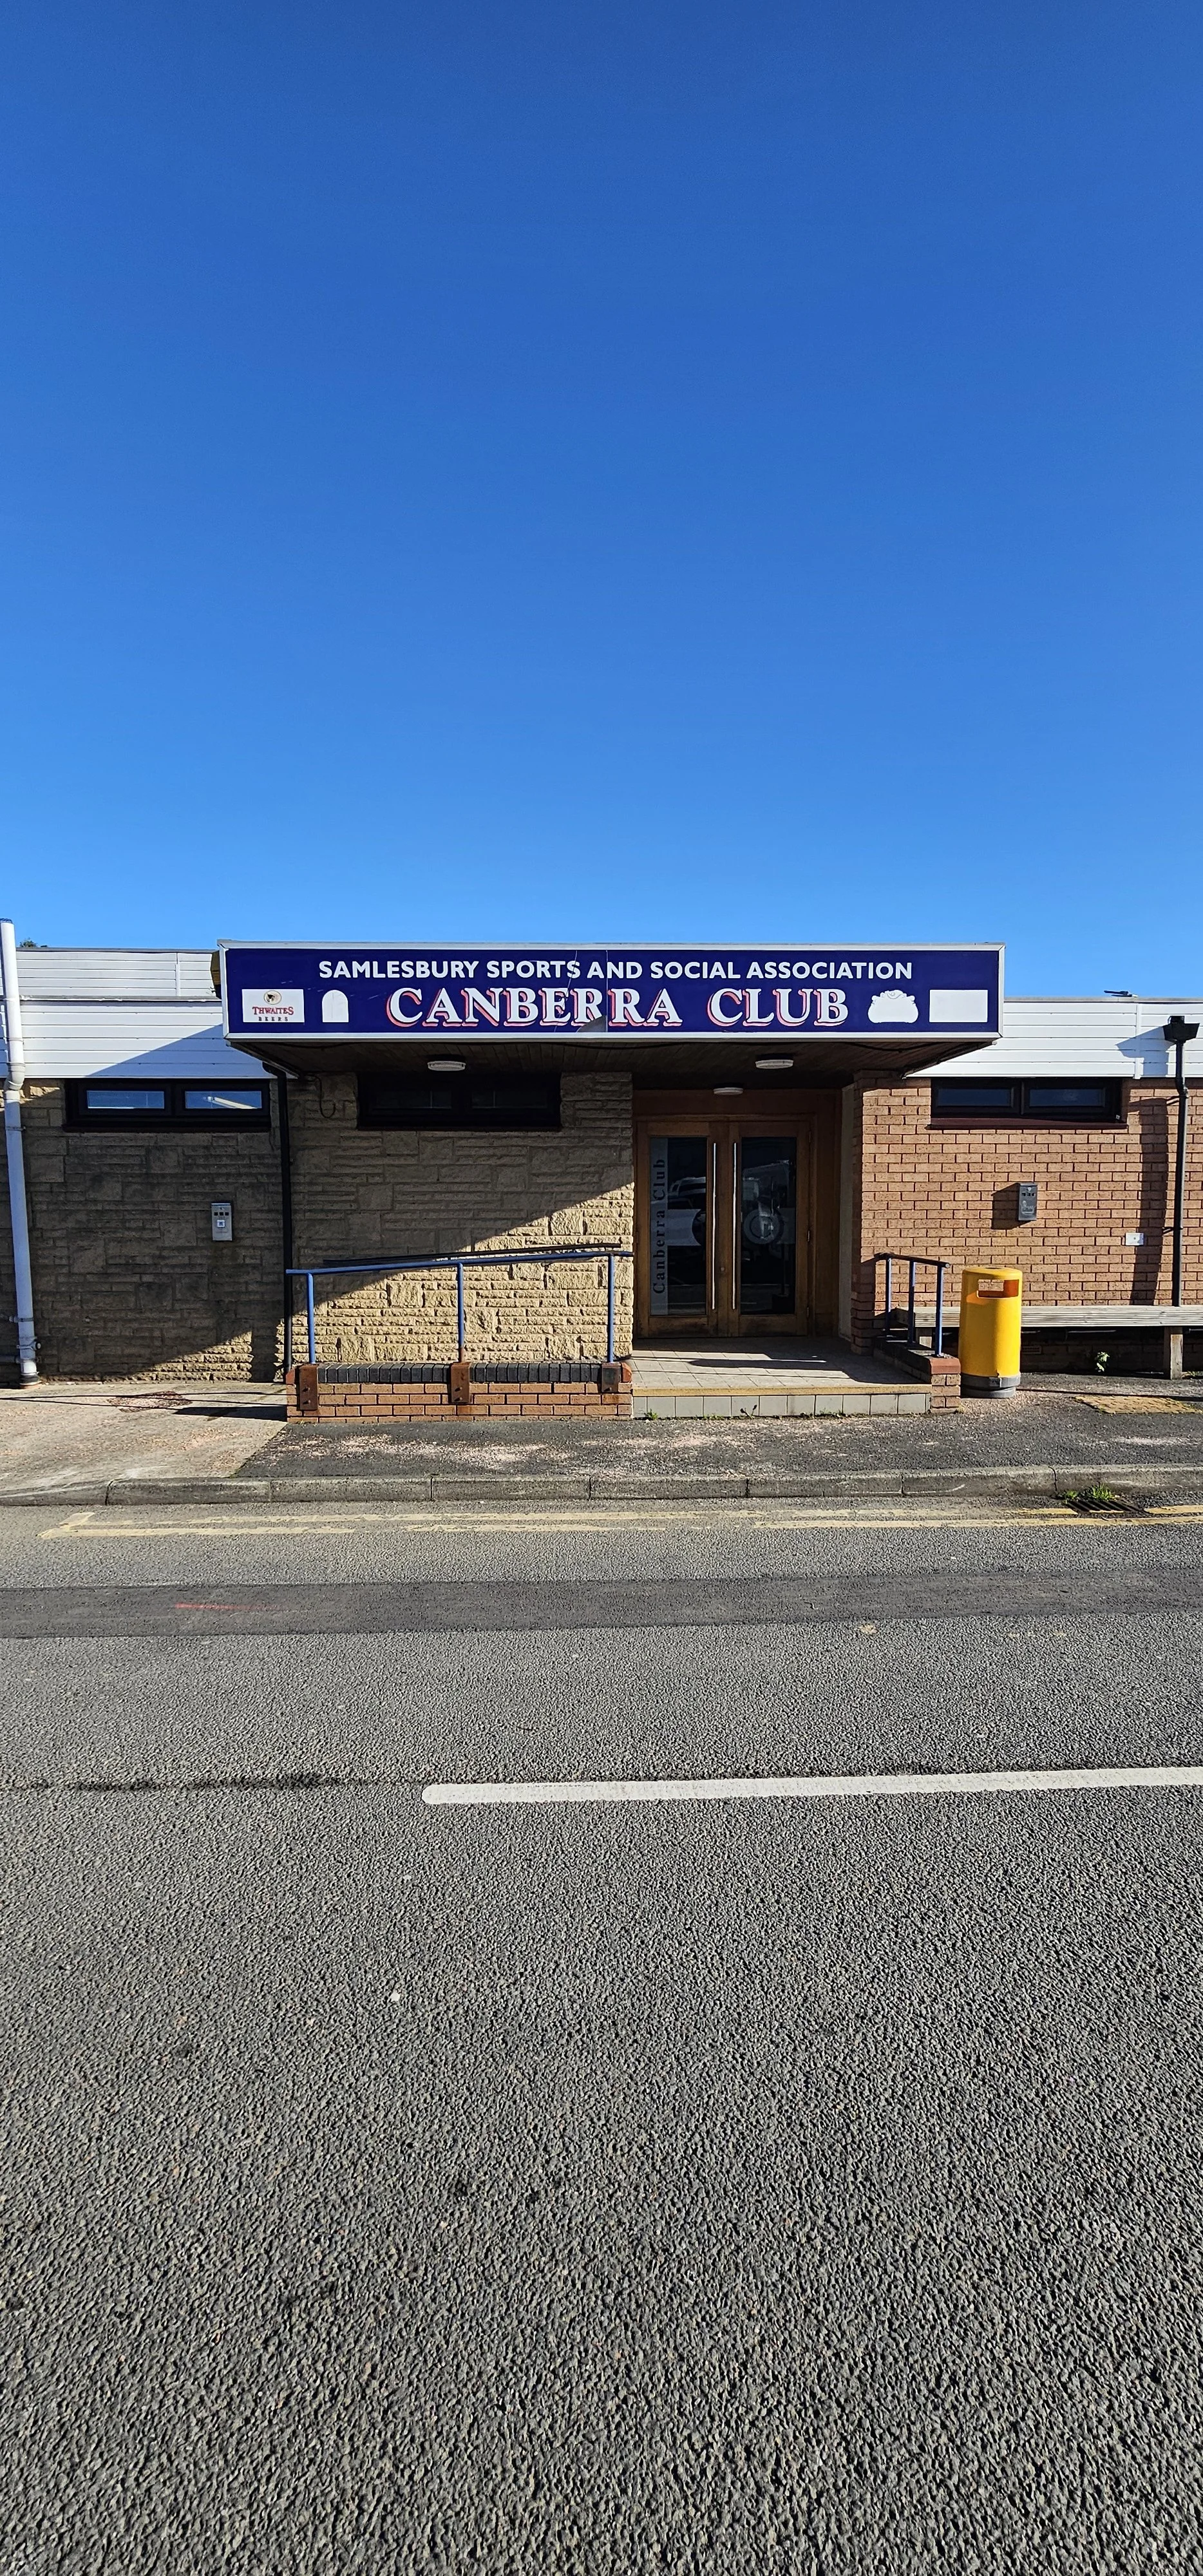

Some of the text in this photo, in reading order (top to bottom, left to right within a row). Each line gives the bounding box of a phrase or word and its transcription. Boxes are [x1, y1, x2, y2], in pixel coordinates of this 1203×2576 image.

[319, 960, 913, 980] SAMLESBURY SPORTS AND SOCIAL ASSOCIATION
[252, 1006, 294, 1015] THWAITES
[386, 987, 849, 1027] CANBERRA CLUB
[652, 1159, 666, 1294] Canberra Club
